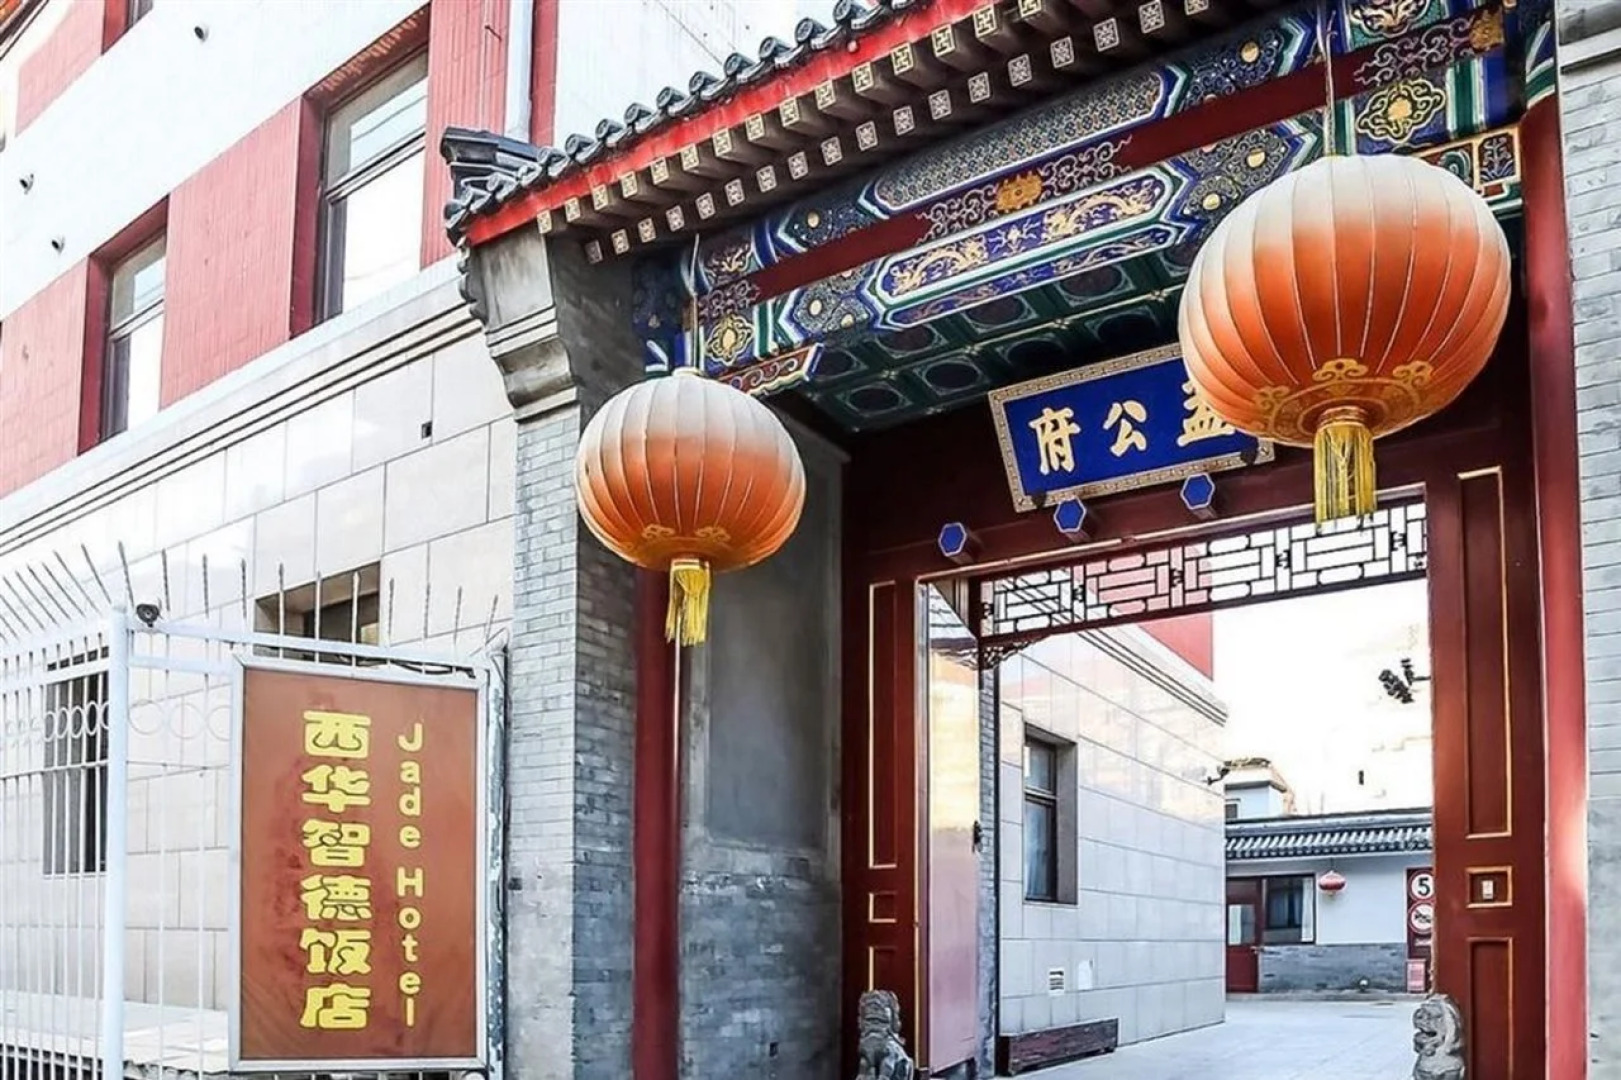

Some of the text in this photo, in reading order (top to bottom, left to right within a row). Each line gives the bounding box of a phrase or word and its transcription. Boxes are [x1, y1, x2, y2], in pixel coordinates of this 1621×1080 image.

[301, 711, 371, 1029] 西华智德饭店
[396, 722, 425, 1027] Jade Hotel
[1418, 877, 1430, 896] 5
